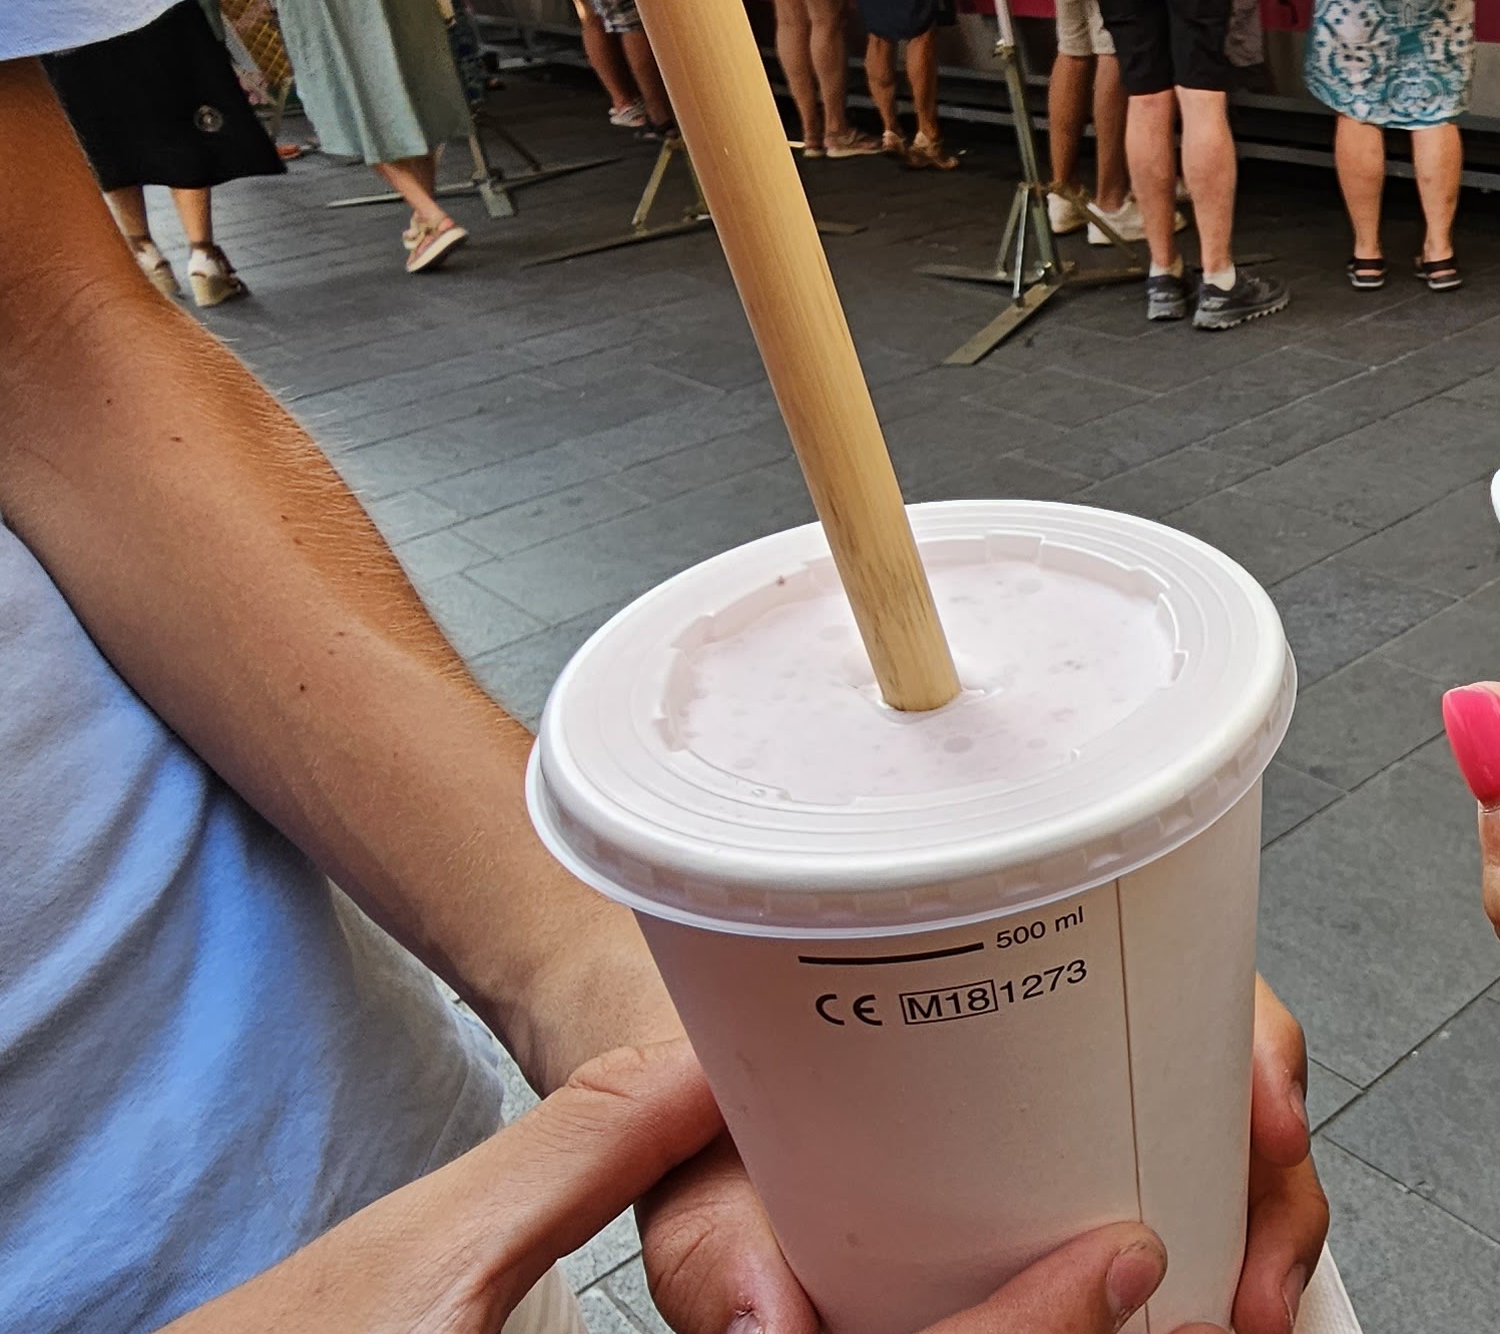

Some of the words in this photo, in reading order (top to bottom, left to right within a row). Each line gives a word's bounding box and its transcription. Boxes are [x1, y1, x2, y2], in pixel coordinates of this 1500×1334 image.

[996, 921, 1047, 950] 500
[1055, 905, 1085, 933] ml
[906, 986, 991, 1021] M18
[1000, 958, 1088, 1005] 1273
